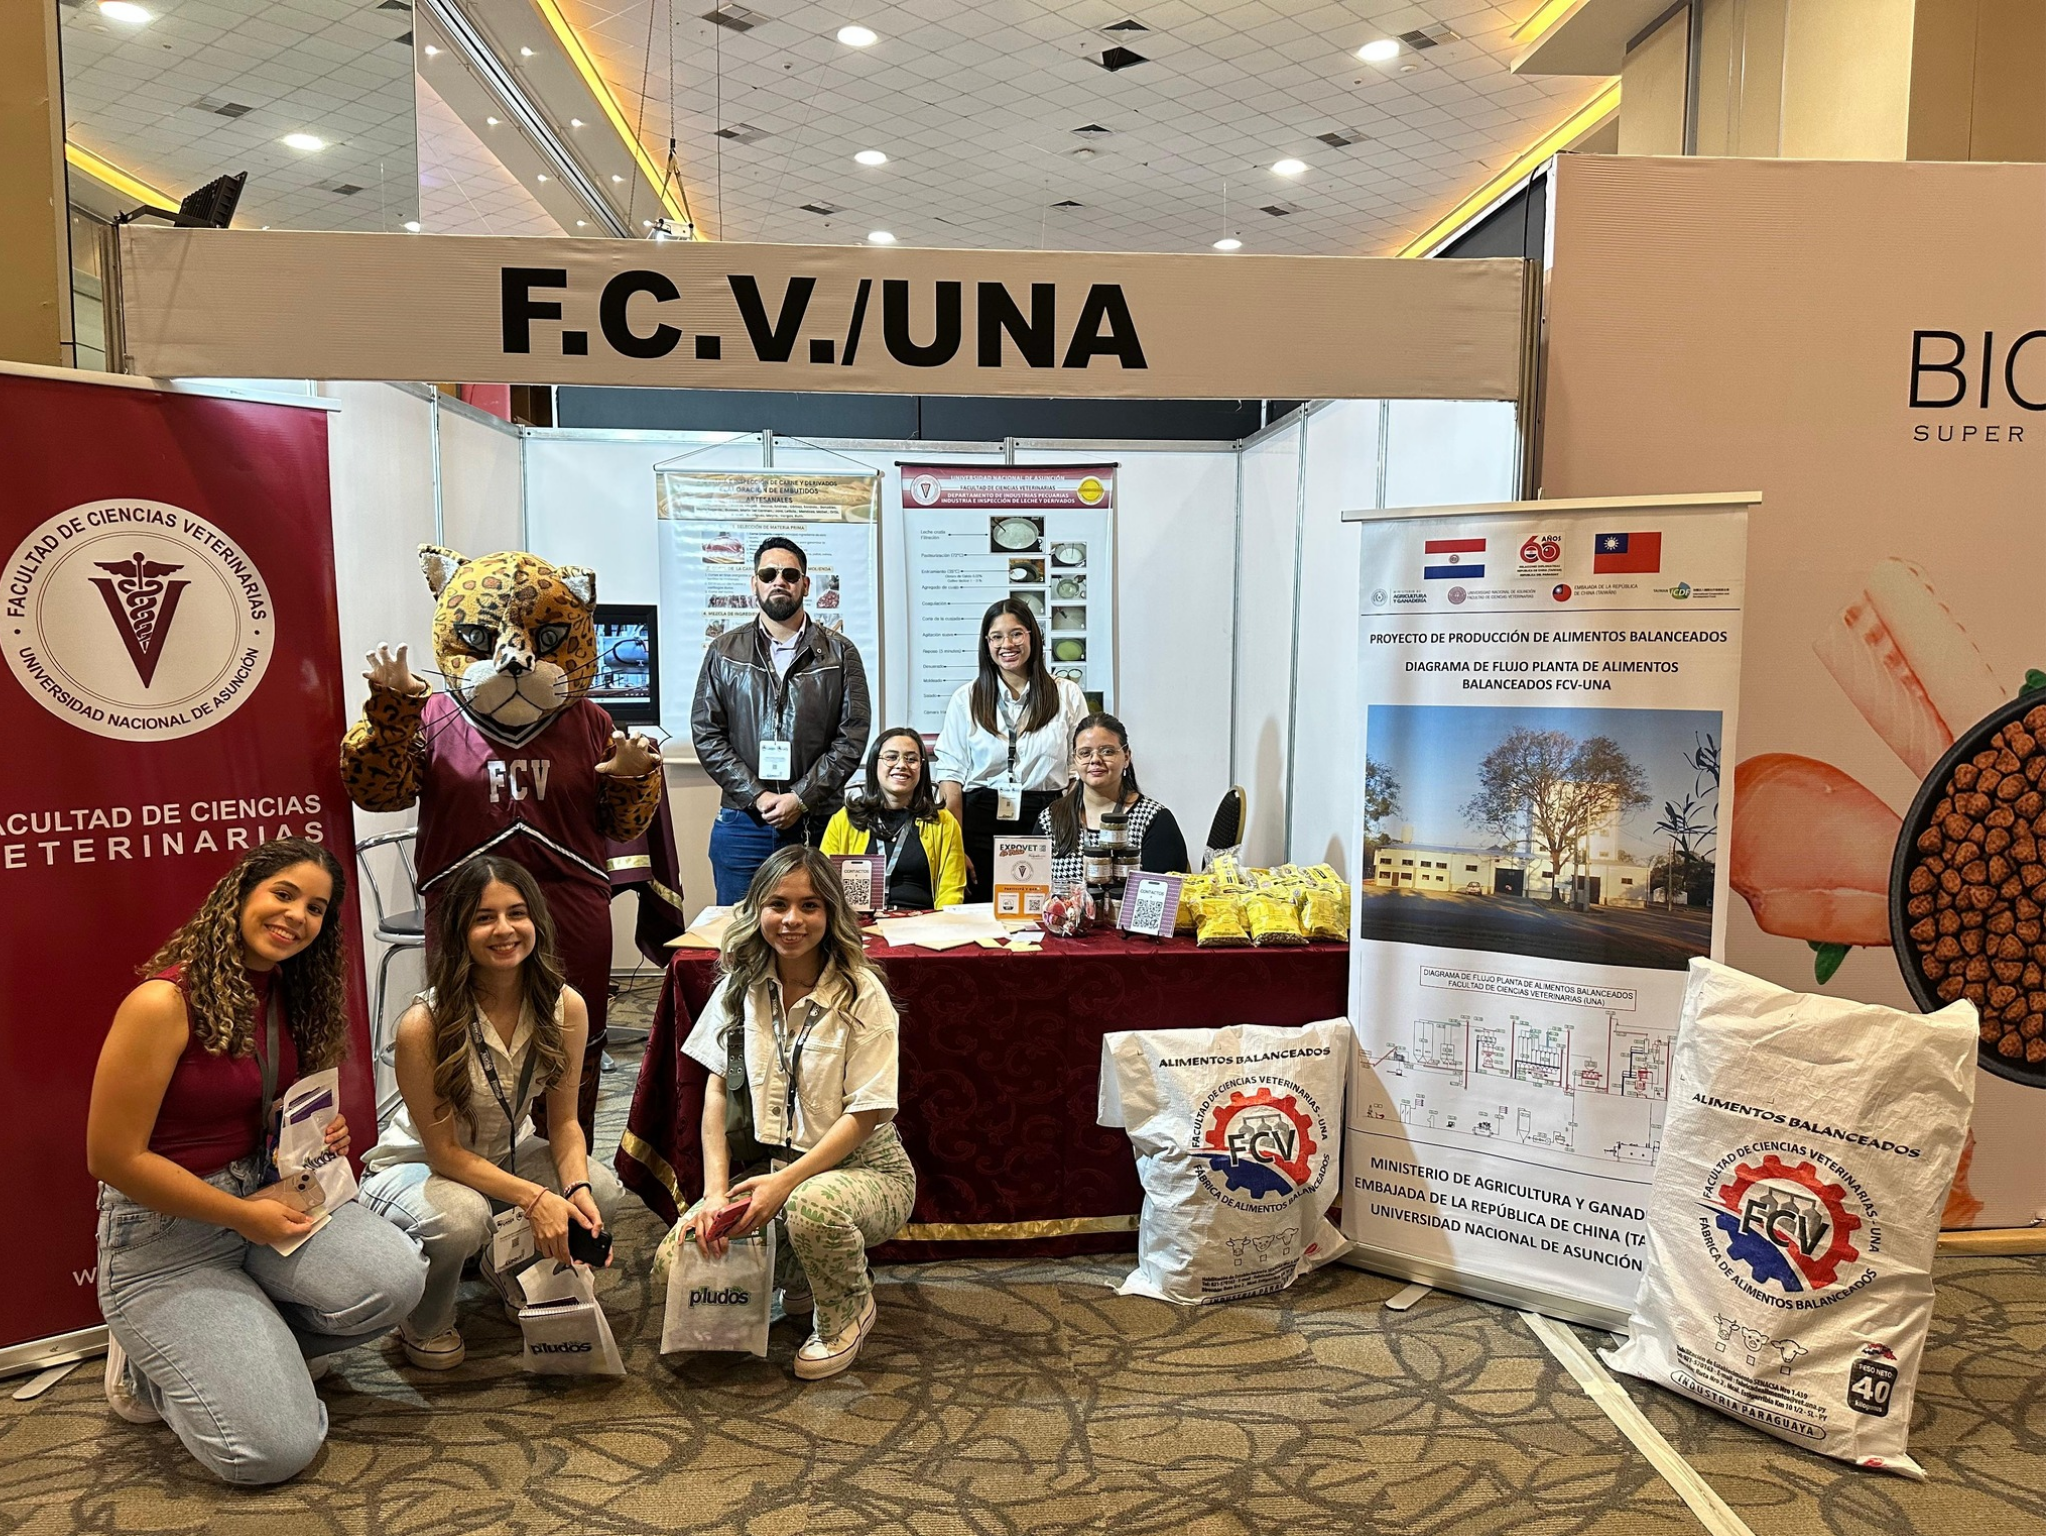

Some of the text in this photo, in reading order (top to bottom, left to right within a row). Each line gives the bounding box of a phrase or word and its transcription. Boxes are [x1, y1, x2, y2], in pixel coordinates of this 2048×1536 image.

[501, 267, 1148, 369] F.C.V./UNA
[1913, 425, 2024, 442] SUPER
[7, 507, 267, 620] FACULTAD DE CIENCIAS VETERINARIAS
[1520, 535, 1561, 564] 60
[1370, 630, 1728, 644] PROYECTO DE PRODUCCIÓN DE ALIMENTOS BALANCEADOS
[1405, 661, 1679, 673] DIAGRAMA DE FLUJO PLANTA DE ALIMENTOS
[19, 646, 259, 730] UNIVERSIDAD NACIONAL DE ASUNCIÓN
[1462, 679, 1612, 690] BALANCEADOS FCV-UNA
[487, 759, 550, 803] FCV
[142, 803, 182, 826] DE
[190, 794, 322, 822] CIENCIAS
[1000, 843, 1038, 852] EXPOVET
[1140, 888, 1165, 896] CONTACTOS
[1423, 968, 1460, 979] DIAGRAMA
[1473, 974, 1495, 983] FLUJO
[1497, 976, 1523, 987] PLANTA
[1524, 980, 1533, 988] DE
[1534, 982, 1576, 994] ALIMENTOS
[1577, 987, 1634, 1000] BALANCEADOS
[1448, 980, 1485, 990] FACULTAD
[1497, 985, 1529, 996] CIENCIAS
[1530, 990, 1582, 1003] VETERINARIAS
[1583, 997, 1605, 1007] (UNA)
[1159, 1047, 1331, 1068] ALIMENTOS BALANCEADOS
[1192, 1075, 1328, 1148] FACULTAD DE CIENCIAS VETERINARIAS UNA
[1692, 1093, 1921, 1159] ALIMENTOS BALANCEADOS
[1228, 1129, 1296, 1165] FCV
[1221, 1194, 1234, 1206] DE
[1235, 1201, 1288, 1213] ALIMENTOS
[1288, 1153, 1330, 1206] BALANCEADOS
[1371, 1157, 1648, 1221] MINISTERIO DE AGRICULTURA Y GANAD
[1703, 1141, 1881, 1253] FACULTAD DE CIENCIAS VETERINARIAS UNA
[1354, 1177, 1426, 1202] EMBAJADA
[1429, 1192, 1448, 1205] DE
[1451, 1196, 1468, 1210] LA
[1471, 1200, 1546, 1227] REPÚBLICA
[1550, 1217, 1569, 1231] DE
[1573, 1222, 1620, 1242] CHINA
[1370, 1203, 1642, 1272] UNIVERSIDAD NACIONAL DE ASUNCIÓN
[1741, 1199, 1830, 1256] FCV
[1700, 1217, 1877, 1310] FÁBRICA DE ALIMENTOS BALANCEADOS
[689, 1286, 750, 1309] pludos
[530, 1341, 592, 1355] pludos
[1858, 1363, 1876, 1374] PESO
[1754, 1378, 1779, 1391] SENACSA
[1780, 1386, 1790, 1394] Nro
[1851, 1375, 1891, 1404] 40
[1677, 1373, 1815, 1436] INDUSTRIA PARAGUAYA
[1774, 1400, 1785, 1408] Km
[1785, 1403, 1793, 1411] 10
[1794, 1406, 1804, 1414] 1/2
